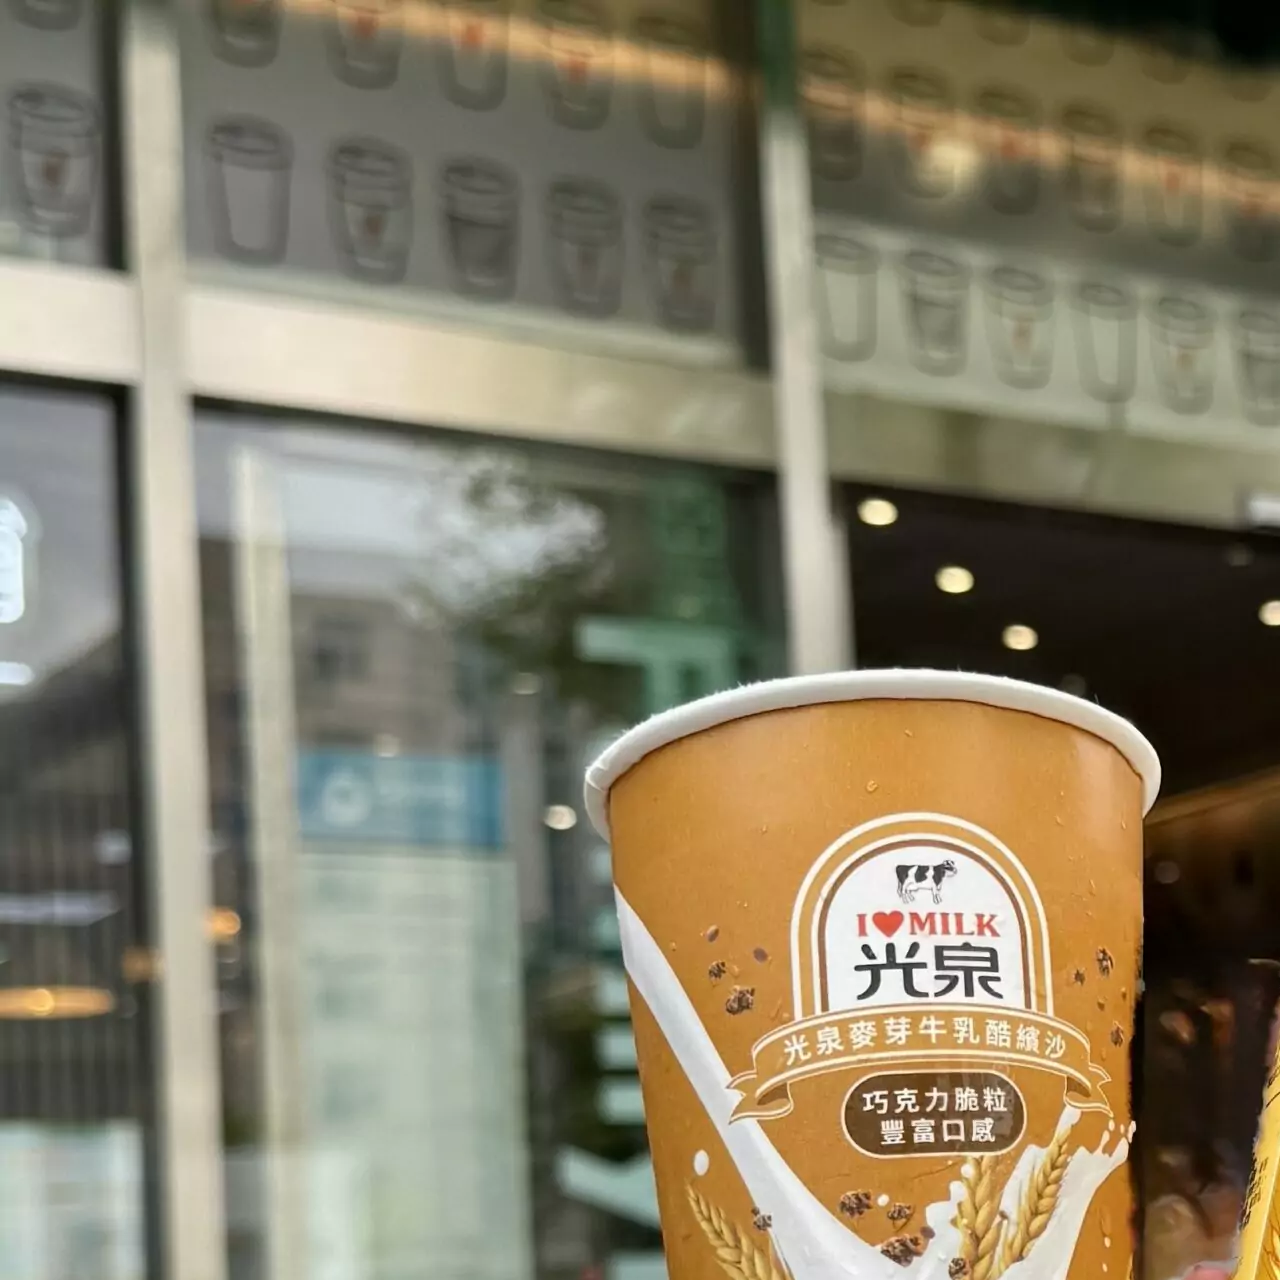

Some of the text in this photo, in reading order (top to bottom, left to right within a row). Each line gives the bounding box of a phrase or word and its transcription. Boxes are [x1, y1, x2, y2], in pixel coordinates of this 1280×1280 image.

[856, 912, 1001, 937] I MILK
[854, 941, 1004, 1000] 光泉
[784, 1015, 1067, 1066] 光泉麥芽牛乳酷繽沙
[862, 1087, 1008, 1115] 巧克力脆粒
[880, 1117, 996, 1146] 豐富口感
